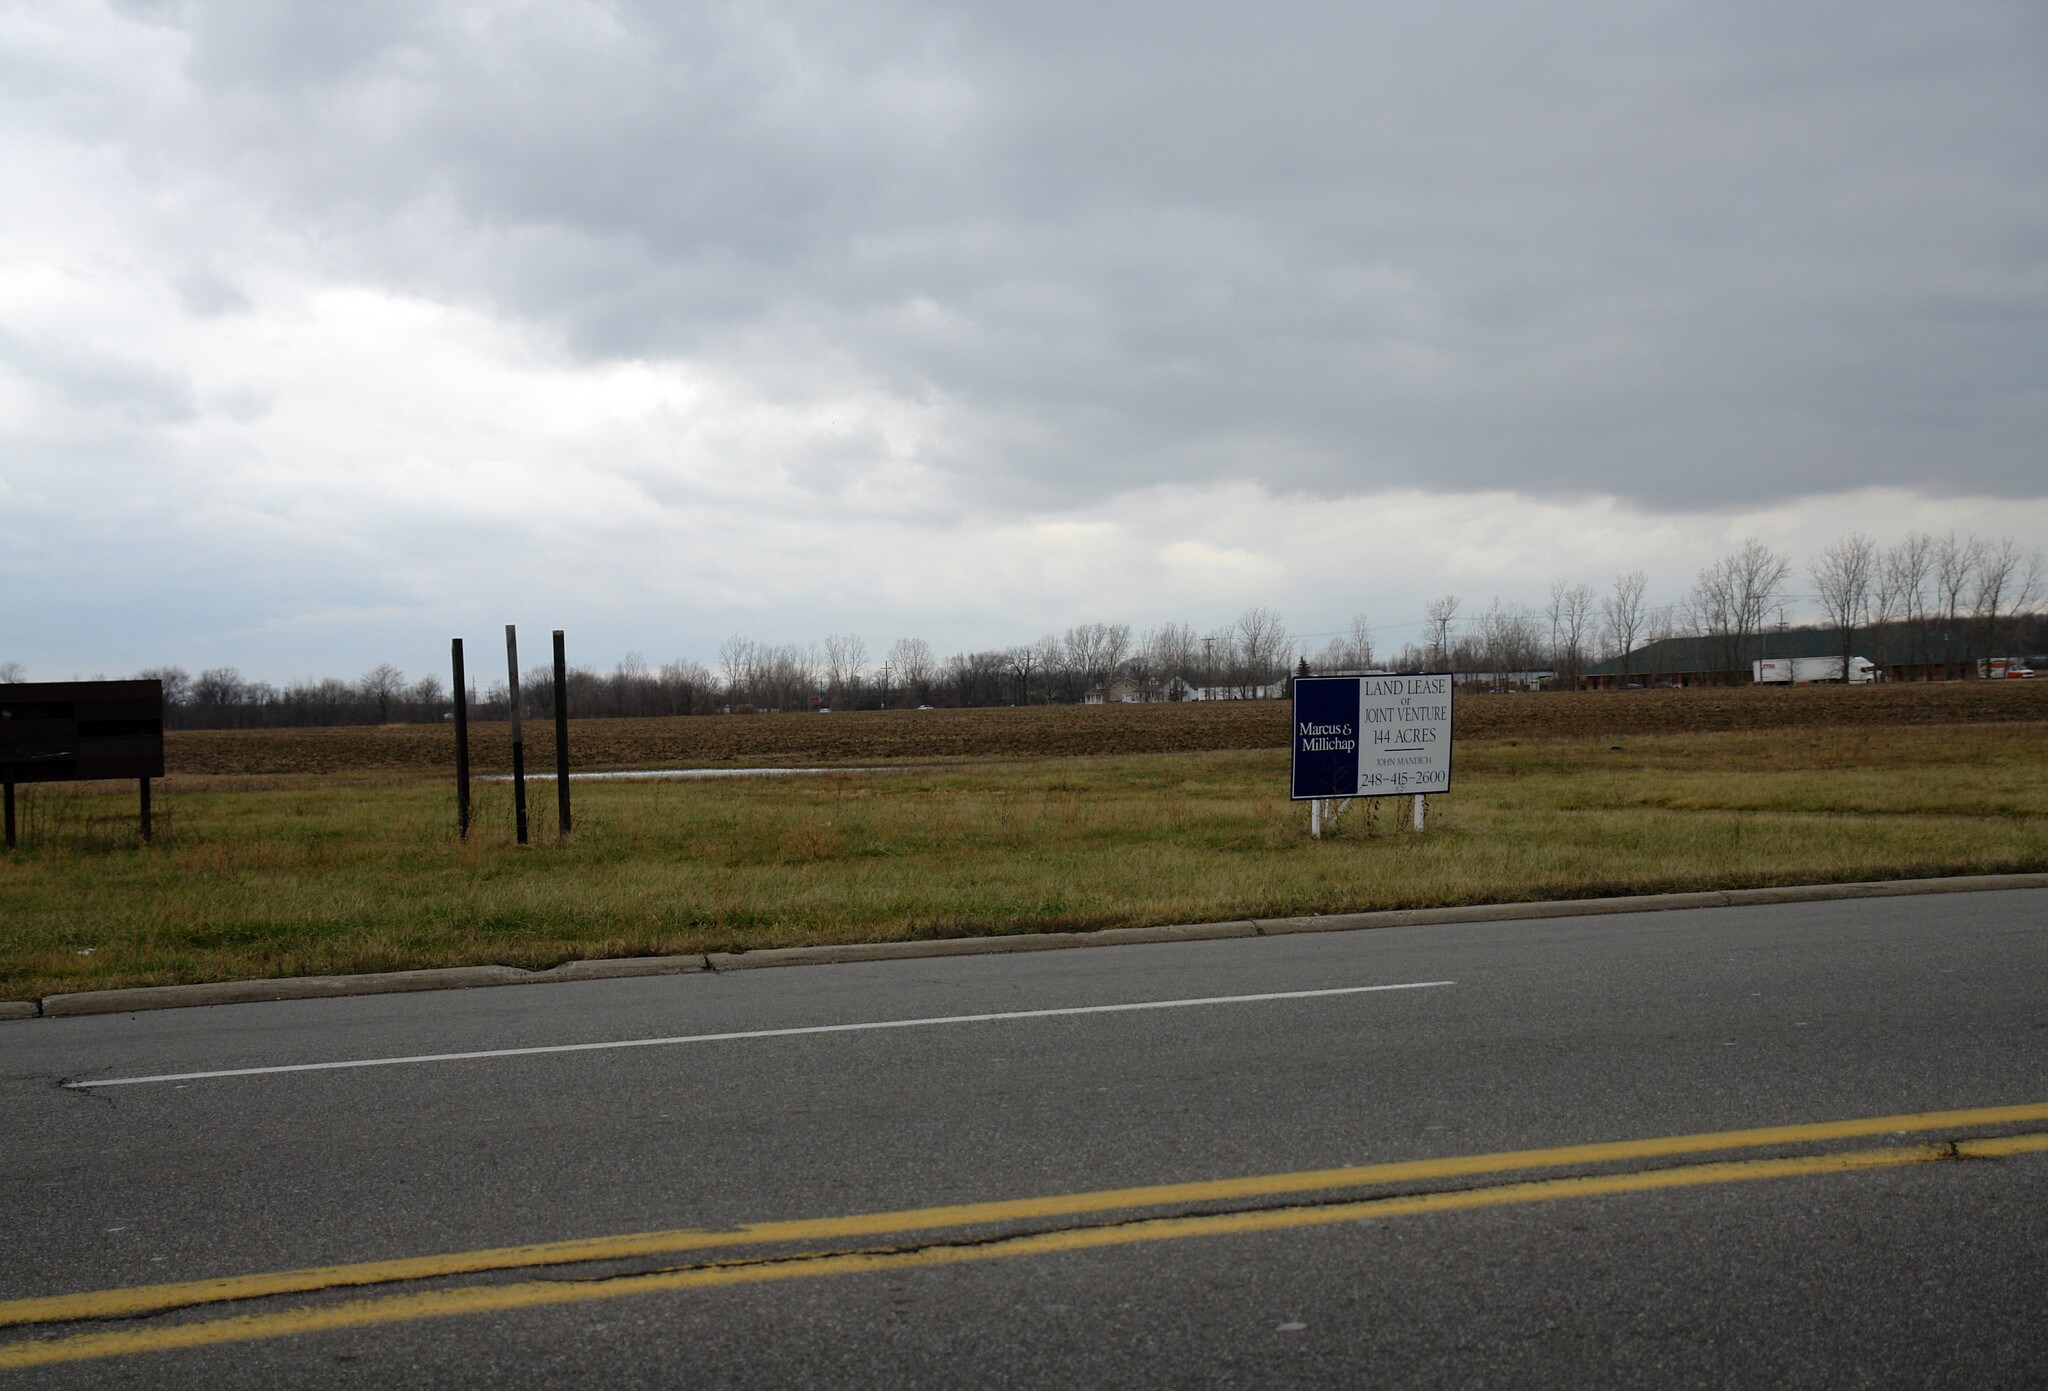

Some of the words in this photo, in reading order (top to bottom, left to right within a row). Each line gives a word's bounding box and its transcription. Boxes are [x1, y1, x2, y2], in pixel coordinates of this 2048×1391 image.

[1365, 680, 1404, 696] LAND
[1407, 678, 1446, 695] LEASE
[1400, 697, 1412, 705] or
[1364, 707, 1395, 724] JOINT
[1397, 705, 1447, 722] VENTURE
[1299, 722, 1341, 736] Marcus
[1342, 723, 1352, 735] &
[1374, 729, 1391, 744] 144
[1395, 728, 1436, 744] ACRES
[1302, 737, 1355, 753] Millichap
[1376, 757, 1396, 766] JOHN
[1361, 770, 1446, 787] 248-415-2600
